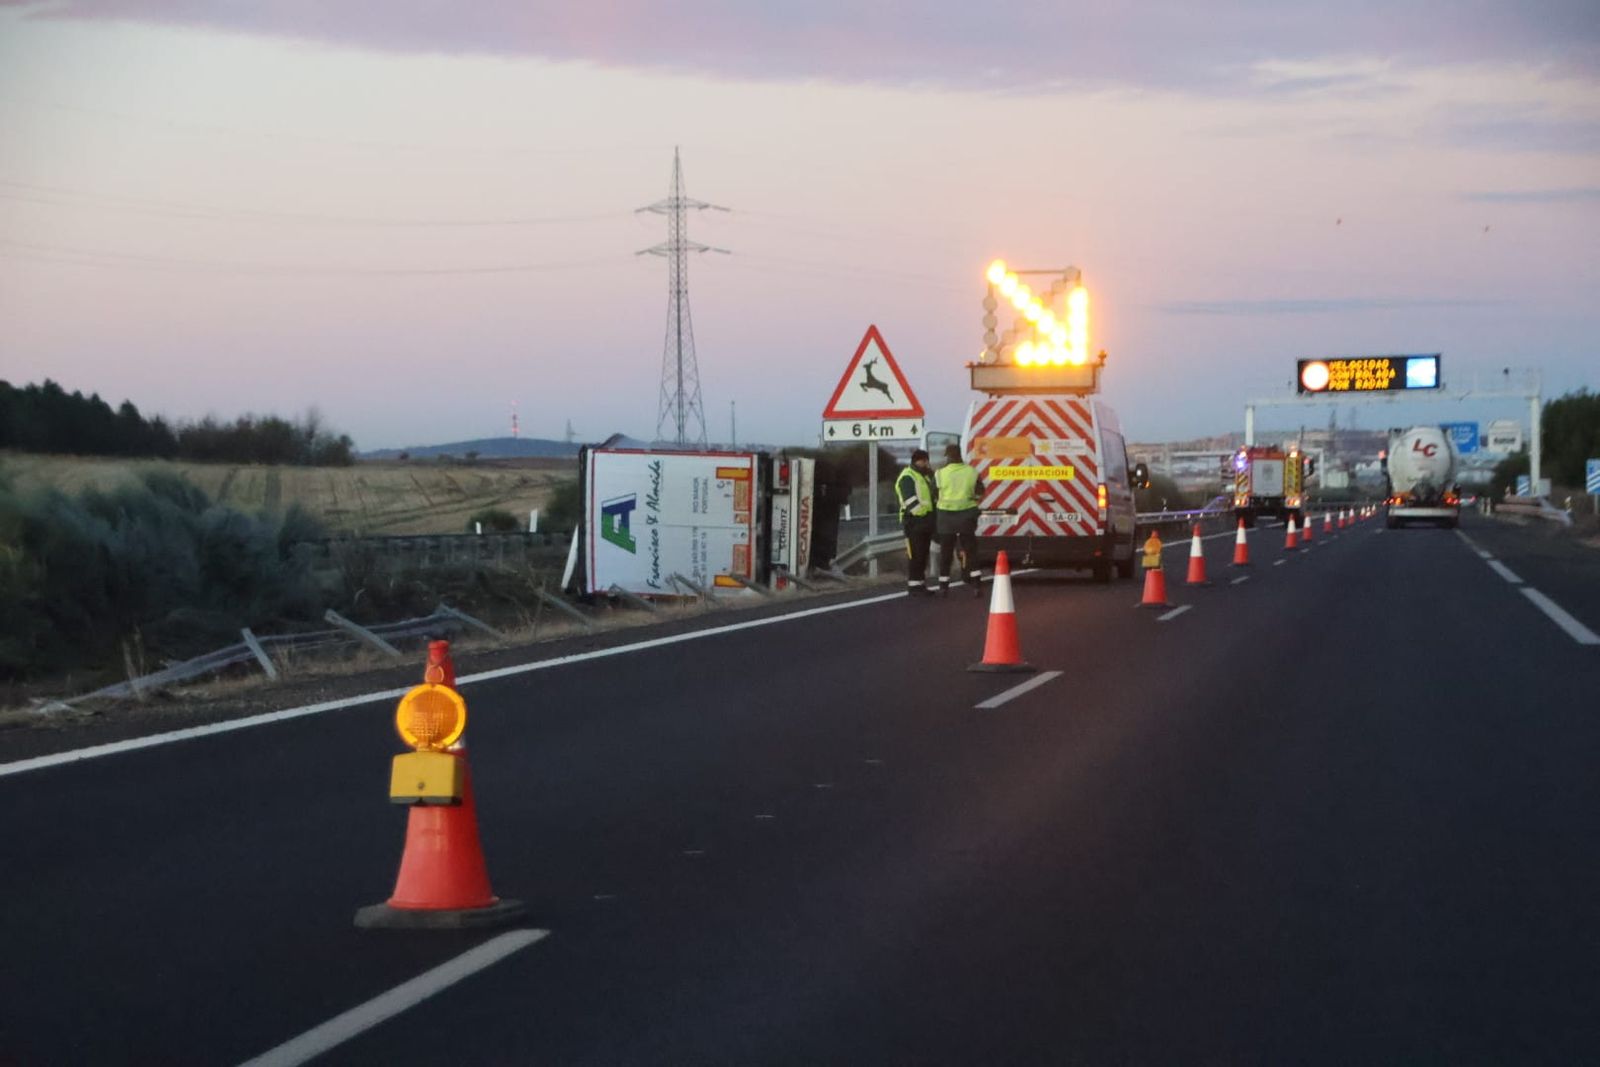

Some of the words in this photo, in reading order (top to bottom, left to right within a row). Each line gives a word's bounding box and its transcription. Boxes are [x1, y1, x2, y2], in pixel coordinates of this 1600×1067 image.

[1329, 359, 1390, 370] VELOCIDAD
[1329, 368, 1396, 380] CONTROLADA
[1329, 380, 1350, 390] POR
[1355, 379, 1389, 390] RADAR
[852, 424, 862, 437] 6
[868, 424, 894, 437] km
[1413, 438, 1438, 457] LC
[646, 460, 661, 513] Almeida
[701, 478, 709, 514] PORTUGAL
[646, 514, 658, 525] &
[799, 496, 810, 566] SCANIA
[646, 528, 661, 589] Francisco
